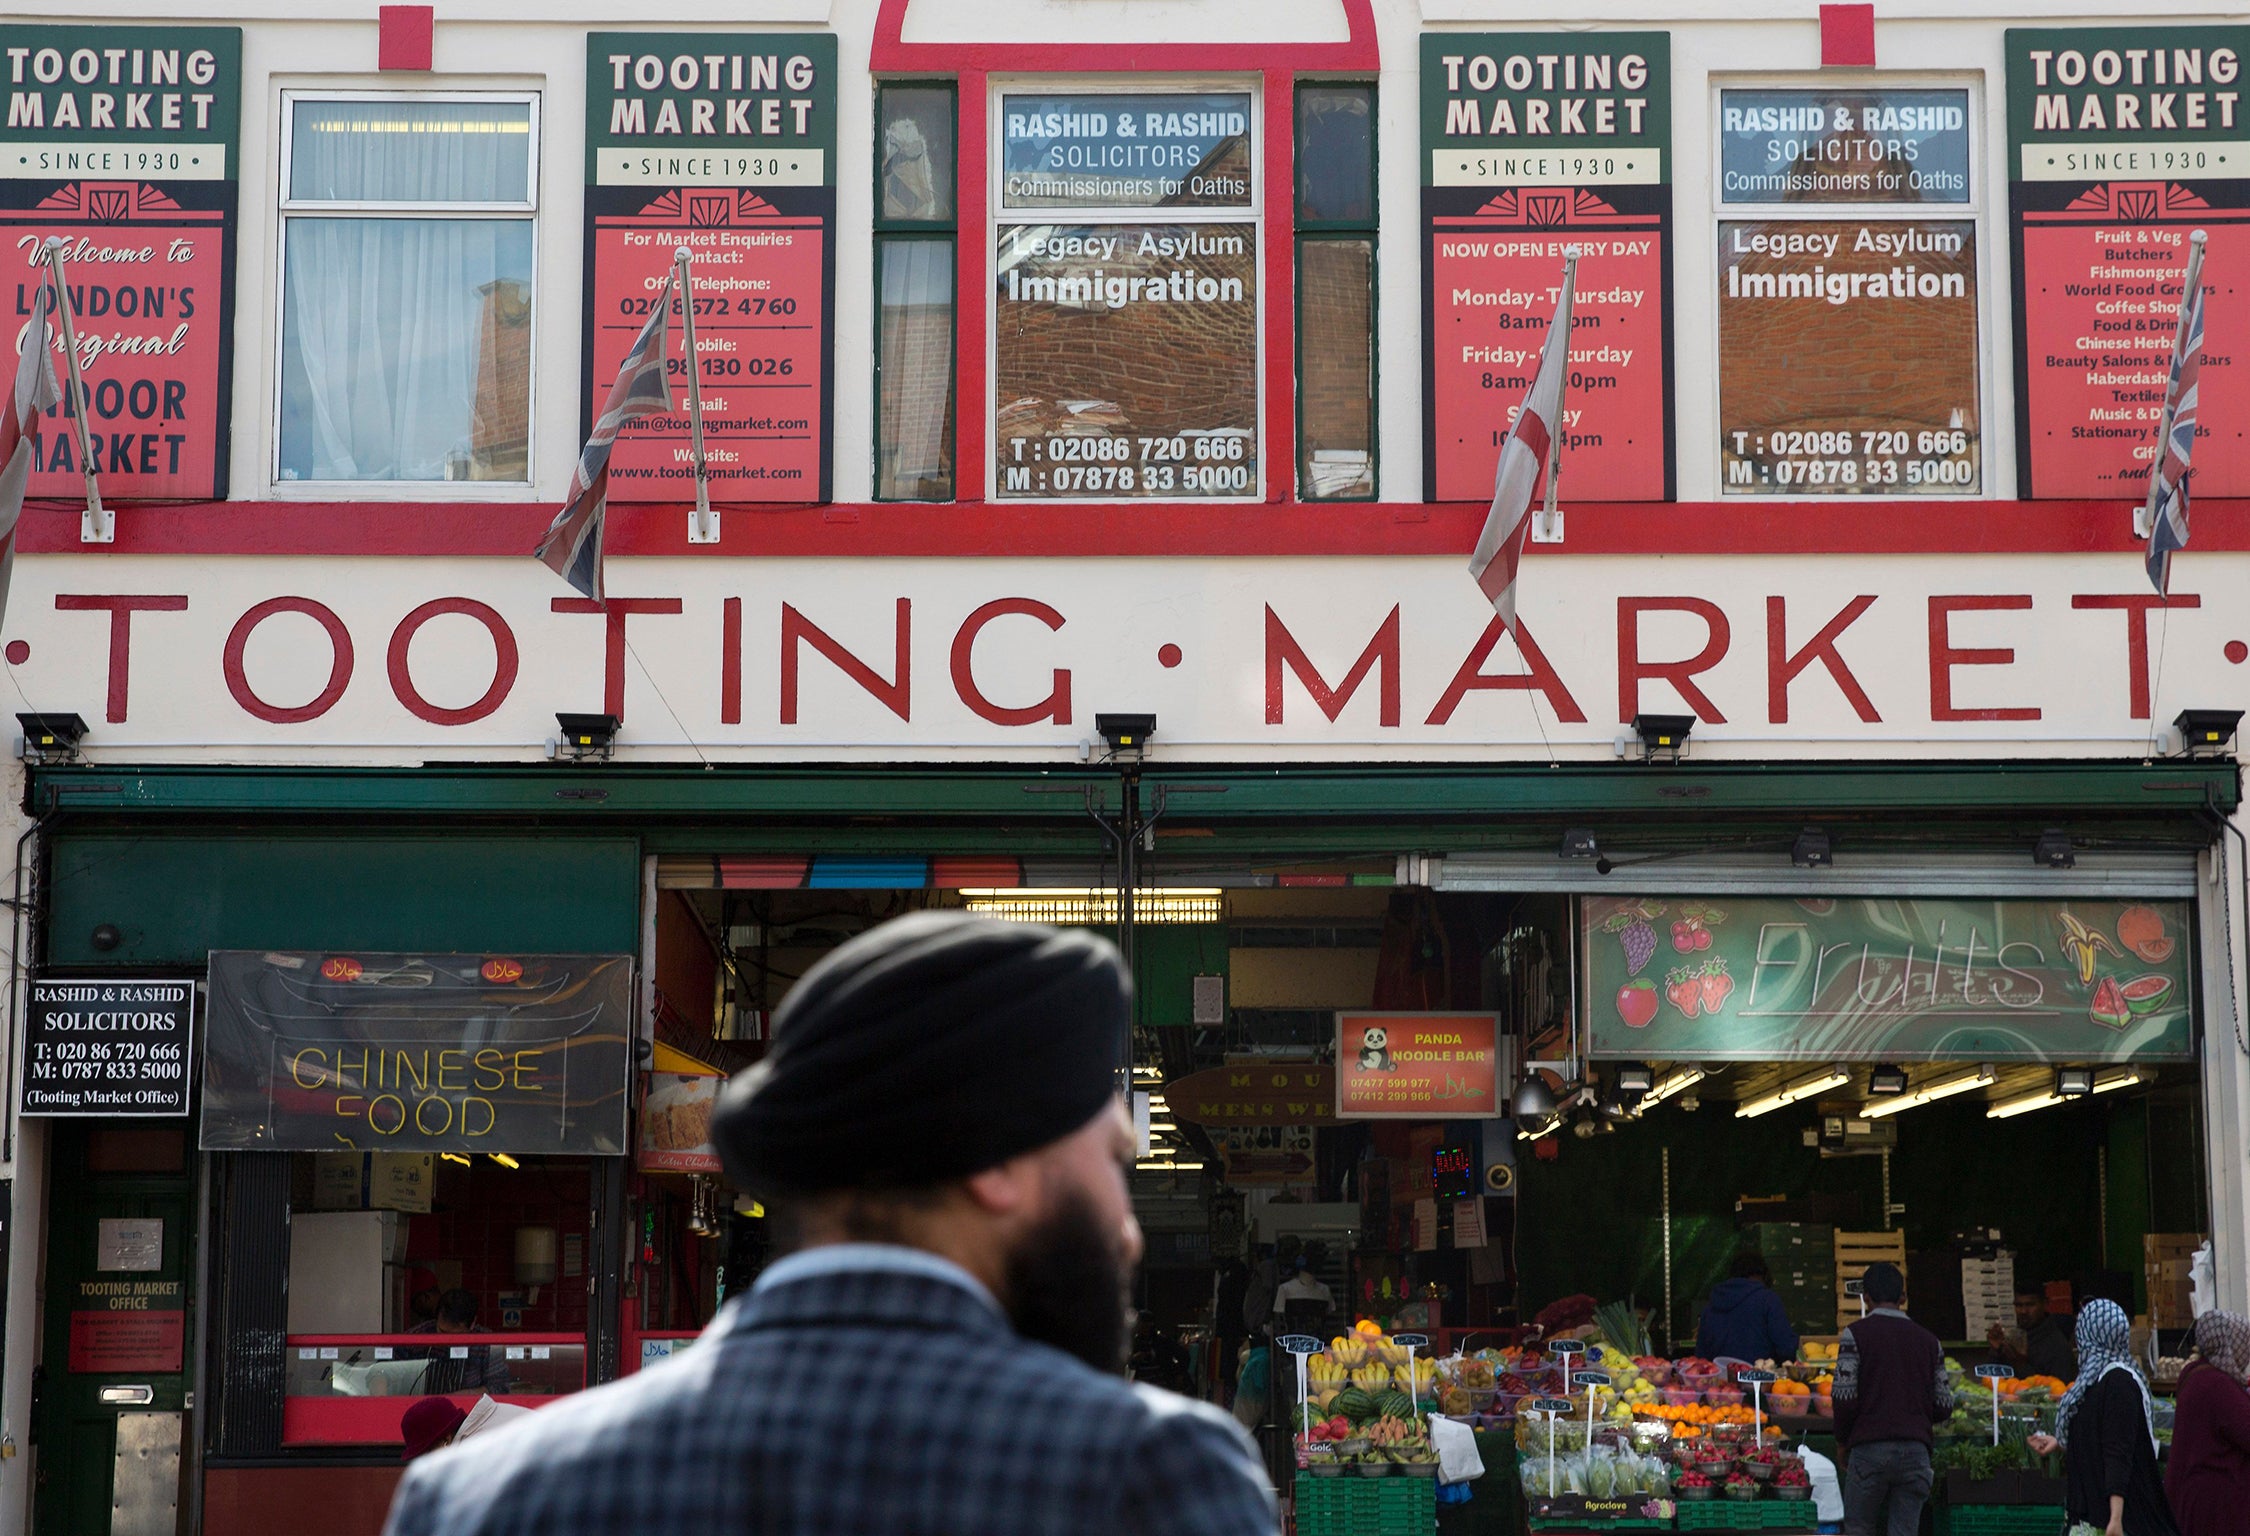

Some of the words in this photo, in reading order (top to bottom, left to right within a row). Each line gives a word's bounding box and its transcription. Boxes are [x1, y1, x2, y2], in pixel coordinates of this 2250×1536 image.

[7, 47, 216, 86] TOOTING
[608, 55, 815, 91] TOOTING
[1441, 55, 1648, 91] TOOTING
[2030, 48, 2239, 86] TOOTING
[7, 92, 215, 131] MARKET
[608, 98, 813, 135] MARKET
[1445, 98, 1647, 135] MARKET
[1724, 108, 1825, 132] RASHID
[1832, 107, 1855, 132] &
[1862, 107, 1963, 131] RASHID
[2033, 92, 2239, 131] MARKET
[1008, 113, 1108, 138] RASHID
[1116, 113, 1138, 137] &
[1145, 112, 1246, 137] RASHID
[1050, 145, 1201, 168] SOLICITORS
[1767, 139, 1919, 162] SOLICITORS
[39, 152, 112, 170] SINCE
[122, 152, 181, 170] 1930
[641, 158, 712, 176] SINCE
[723, 158, 780, 176] 1930
[1477, 158, 1548, 176] SINCE
[1559, 157, 1615, 175] 1930
[2067, 152, 2140, 171] SINCE
[2150, 151, 2208, 169] 1930
[1008, 175, 1153, 197] Commissioners
[1158, 175, 1185, 196] for
[1190, 175, 1245, 196] Oaths
[1725, 170, 1871, 192] Commissioners
[1876, 170, 1903, 190] for
[1908, 170, 1964, 190] Oaths
[624, 232, 651, 246] For
[656, 232, 717, 246] Market
[721, 232, 793, 249] Enquiries
[1012, 232, 1118, 261] Legacy
[1136, 232, 1243, 261] Asylum
[1733, 228, 1839, 258] Legacy
[1853, 228, 1962, 257] Asylum
[2095, 231, 2132, 243] Fruit
[2137, 231, 2148, 243] &
[2152, 231, 2182, 247] Veg
[17, 234, 156, 268] Welcome
[167, 238, 195, 263] to
[687, 250, 744, 263] ontact:
[1442, 243, 1489, 257] NOW
[1493, 243, 1543, 257] OPEN
[1612, 241, 1651, 256] DAY
[2105, 249, 2173, 260] Butchers
[2090, 266, 2188, 281] Fishmongers
[692, 277, 771, 293] Telephone:
[1008, 269, 1243, 309] Immigration
[1728, 265, 1966, 305] Immigration
[2064, 284, 2111, 296] World
[2115, 284, 2155, 296] Food
[2160, 284, 2216, 296] Grors
[16, 284, 195, 319] LONDON'S
[737, 298, 797, 315] 4760
[2096, 301, 2145, 314] Coffee
[1499, 313, 1601, 332] 8am-pm
[2094, 319, 2131, 331] Food
[2135, 320, 2147, 331] &
[2150, 319, 2178, 331] Drin
[680, 339, 737, 352] obile:
[2076, 337, 2131, 350] Chinese
[2134, 336, 2176, 349] Herba
[702, 359, 741, 375] 130
[748, 359, 793, 375] 026
[2046, 355, 2098, 370] Beauty
[2102, 354, 2150, 367] Salons
[2154, 355, 2165, 367] &
[46, 379, 187, 420] DOOR
[2112, 390, 2166, 402] Textiles
[2089, 408, 2132, 421] Music
[2136, 408, 2148, 420] &
[2071, 426, 2148, 441] Stationary
[1048, 438, 1130, 462] 02086
[1138, 438, 1187, 461] 720
[1194, 438, 1243, 461] 666
[1770, 432, 1852, 455] 02086
[1859, 432, 1910, 455] 720
[1916, 431, 1967, 454] 666
[609, 466, 802, 482] www.tootigmarket.com
[1053, 467, 1135, 490] 07878
[1142, 467, 1175, 490] 33
[1182, 466, 1248, 490] 5000
[1775, 461, 1859, 484] 07878
[1866, 461, 1899, 484] 33
[1906, 461, 1973, 484] 5000
[2118, 464, 2152, 479] and
[55, 594, 1072, 726] TOOTING
[1265, 594, 2201, 727] MARKET
[34, 988, 98, 1001] RASHID
[102, 988, 116, 1001] &
[120, 988, 185, 1001] RASHID
[45, 1012, 176, 1031] SOLICITORS
[1415, 1034, 1462, 1045] PANDA
[34, 1043, 51, 1060] T:
[56, 1043, 86, 1060] 020
[90, 1043, 111, 1060] 86
[115, 1043, 145, 1060] 720
[150, 1043, 181, 1060] 666
[1392, 1050, 1451, 1062] NOODLE
[1455, 1050, 1485, 1062] BAR
[32, 1062, 57, 1079] M:
[62, 1062, 102, 1079] 0787
[106, 1062, 136, 1079] 833
[141, 1062, 181, 1079] 5000
[292, 1047, 545, 1092] CHINESE
[1351, 1078, 1384, 1088] 07477
[1387, 1078, 1407, 1088] 599
[1411, 1078, 1431, 1088] 977
[27, 1090, 81, 1106] (Tooting
[83, 1090, 132, 1103] Market
[135, 1090, 179, 1106] Office)
[1351, 1091, 1384, 1101] 07412
[1199, 1103, 1274, 1117] MENS
[1286, 1103, 1335, 1117] WE
[80, 1282, 130, 1296] TOOTING
[133, 1282, 179, 1295] MARKET
[109, 1297, 148, 1310] OFFICE
